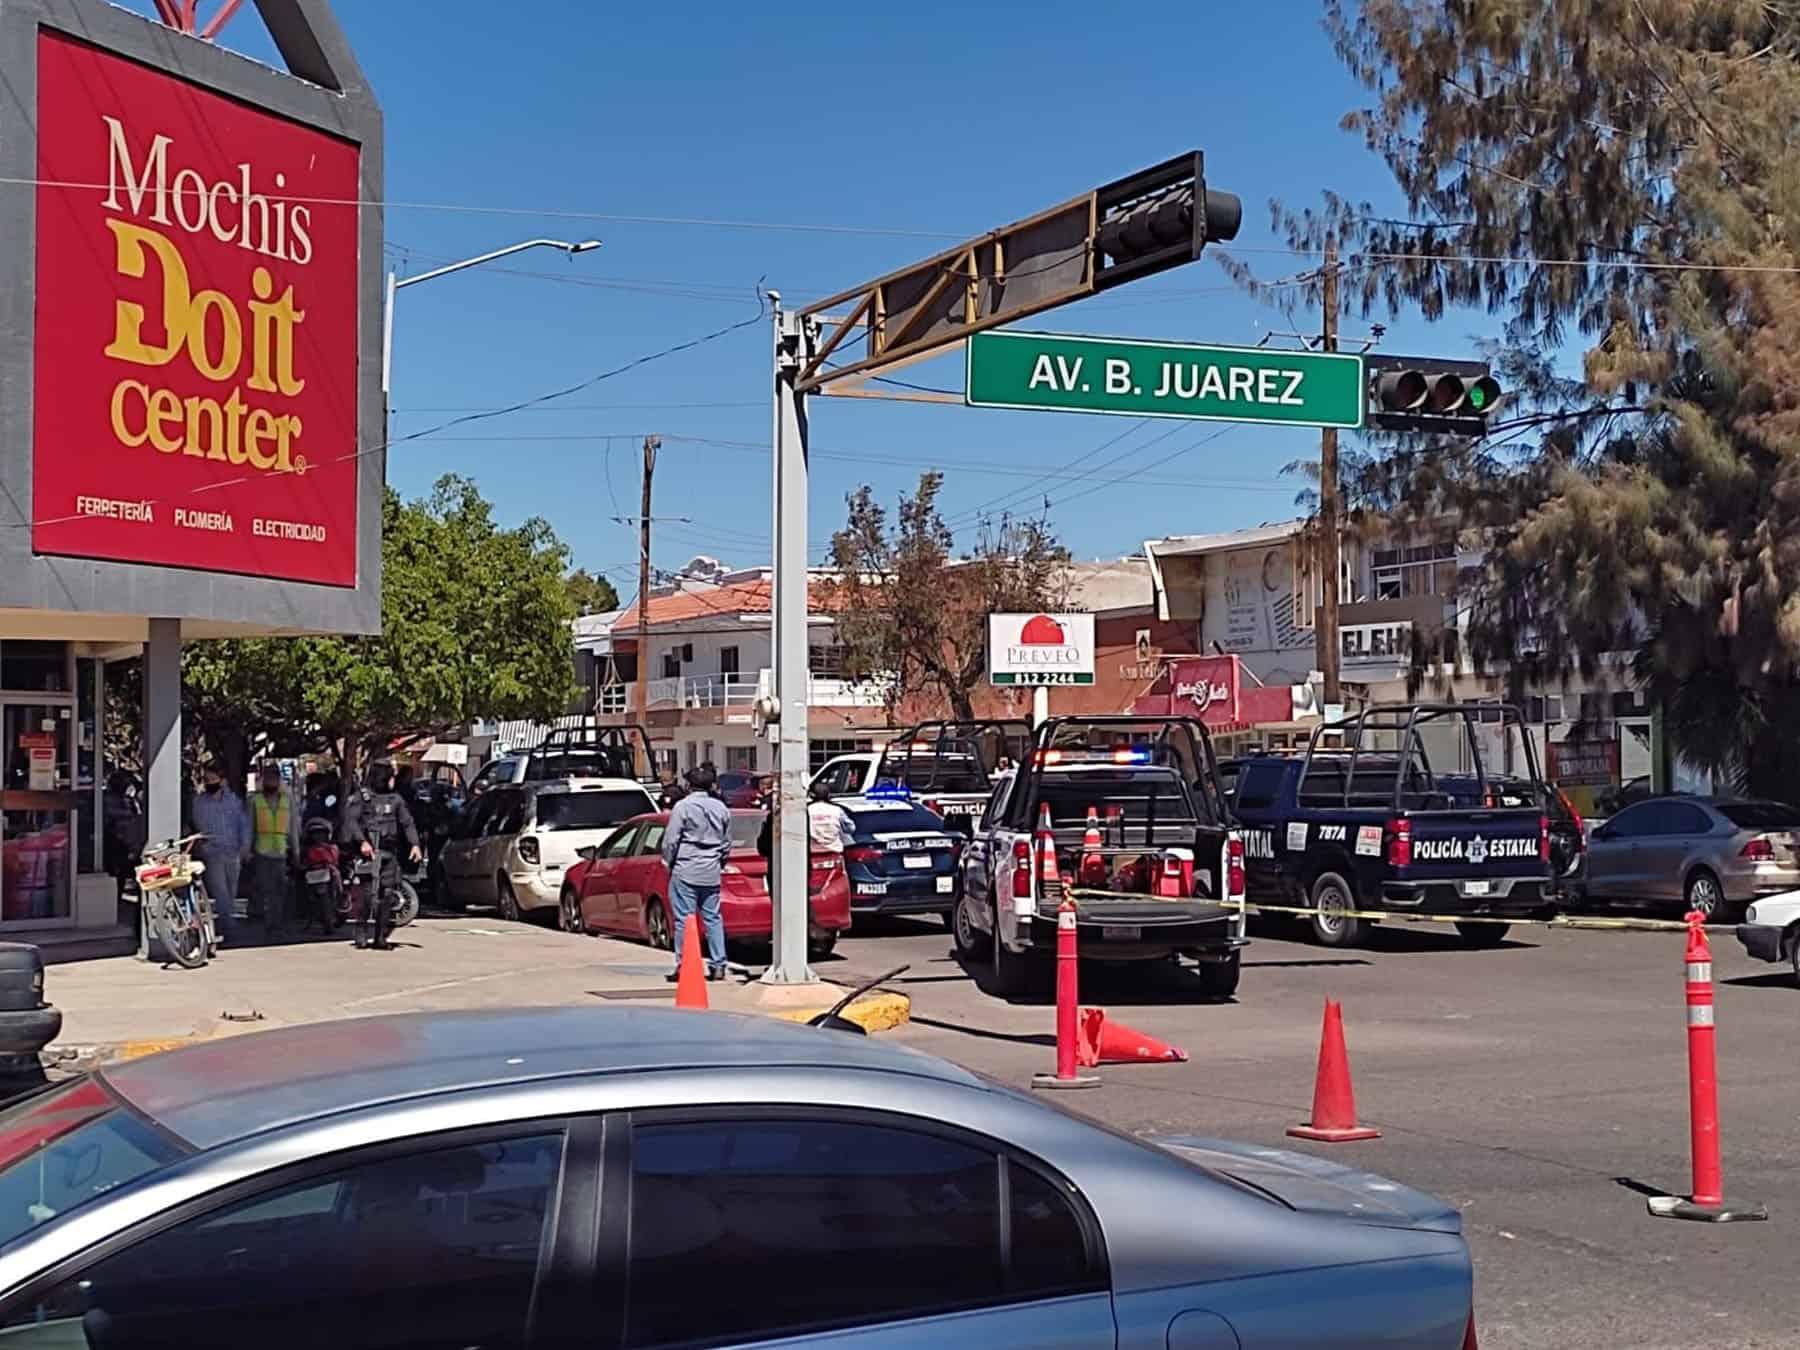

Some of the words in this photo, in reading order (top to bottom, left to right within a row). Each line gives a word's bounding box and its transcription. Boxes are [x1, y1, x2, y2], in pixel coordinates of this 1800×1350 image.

[101, 115, 313, 265] Mochis
[104, 217, 242, 380] Do
[248, 267, 306, 396] it
[1028, 354, 1091, 393] AV.
[1105, 359, 1142, 397] B.
[1153, 362, 1304, 405] JUAREZ
[110, 379, 303, 473] center
[76, 494, 154, 523] FERRETERÍA
[173, 507, 234, 533] PLOMERÍA
[252, 518, 326, 543] ELECTRICIDAD
[1007, 647, 1080, 664] PREVEO
[1241, 829, 1275, 858] TATAL
[1413, 836, 1463, 859] POLICÍA
[1489, 838, 1539, 857] ESTATAL
